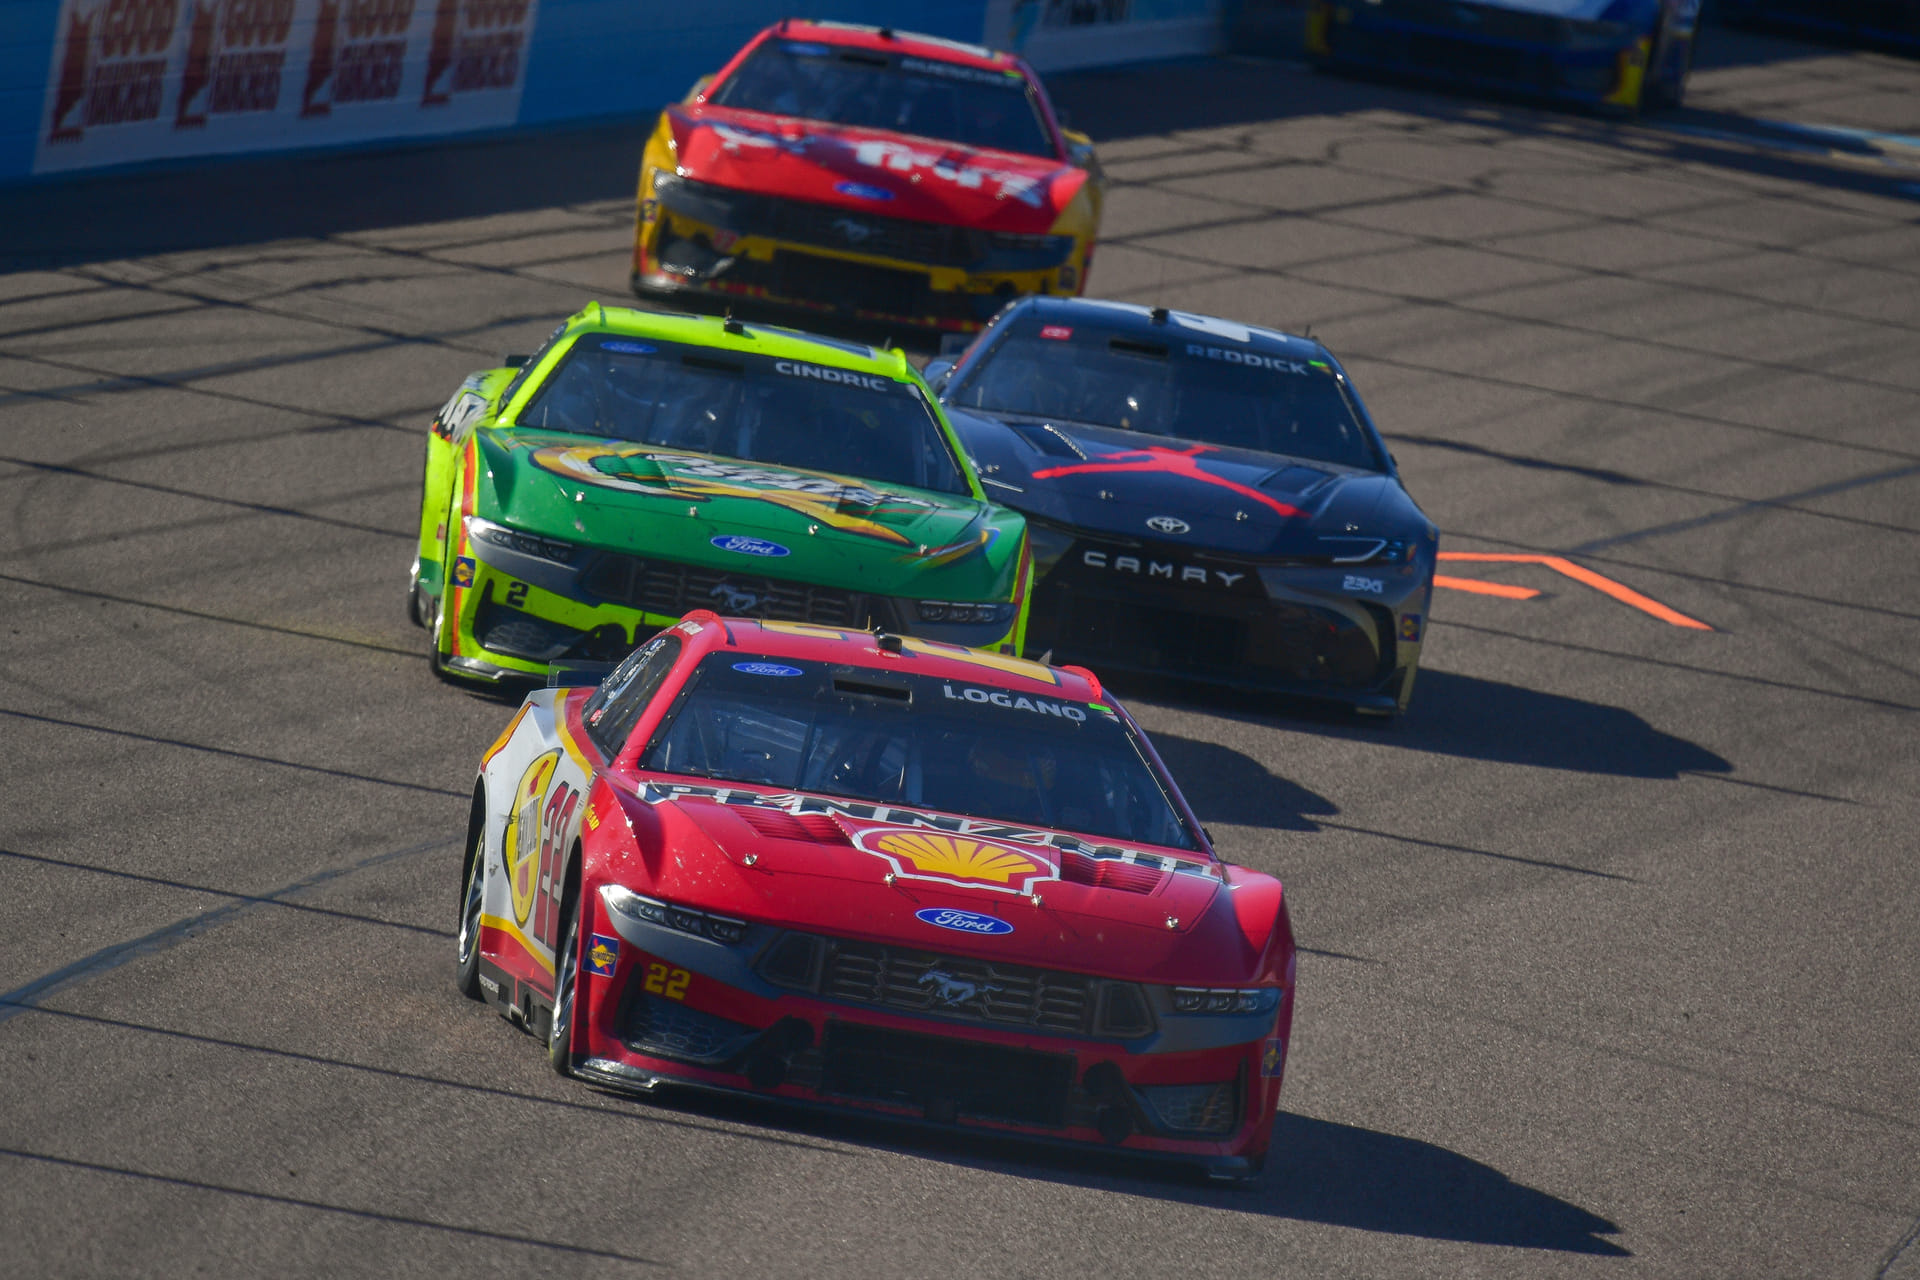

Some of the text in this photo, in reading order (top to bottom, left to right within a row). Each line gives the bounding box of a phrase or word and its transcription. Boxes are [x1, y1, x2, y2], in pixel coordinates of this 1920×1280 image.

[1186, 344, 1308, 376] REDDICK
[775, 361, 888, 392] CINDRIC
[725, 535, 776, 554] Ford
[1084, 550, 1244, 587] CAMRY
[505, 580, 529, 608] 2
[943, 685, 1087, 721] LOGANO
[935, 910, 994, 932] Ford
[644, 962, 691, 1001] 22
